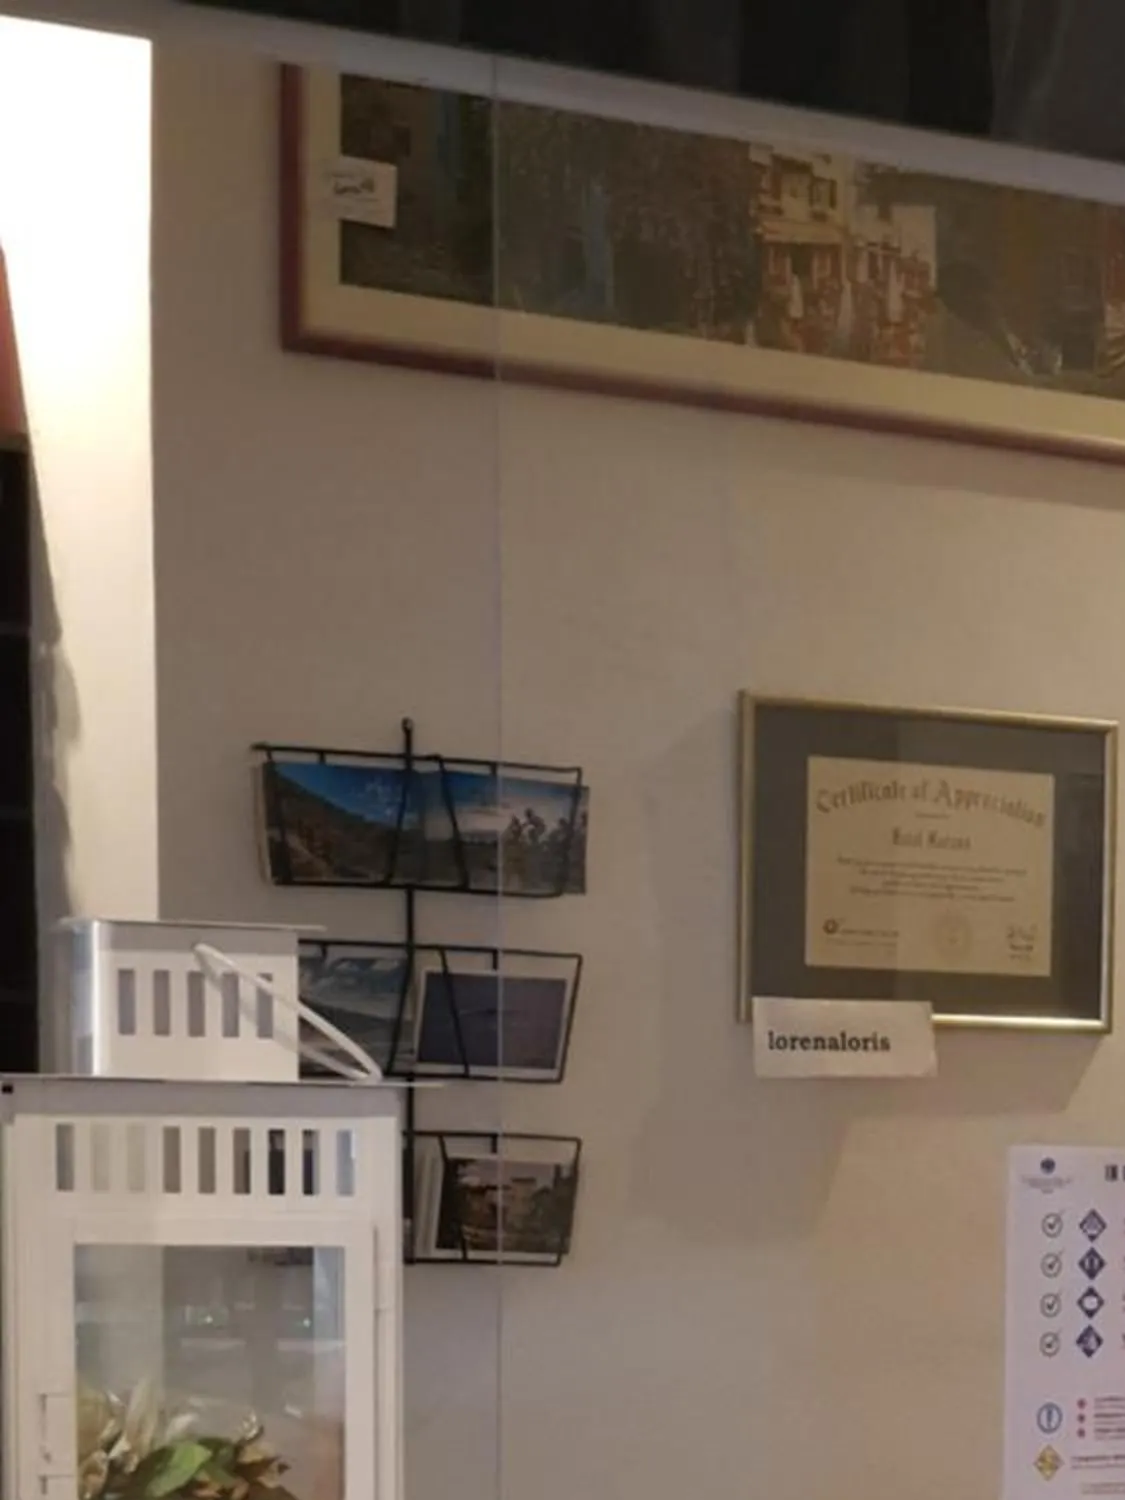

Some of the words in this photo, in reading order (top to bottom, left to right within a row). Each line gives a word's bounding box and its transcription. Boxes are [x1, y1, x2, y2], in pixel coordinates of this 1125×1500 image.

[814, 779, 907, 814] Certificate
[912, 778, 929, 800] of
[934, 779, 1047, 828] Appreciation
[768, 1031, 891, 1053] lorenaloris
[1105, 1164, 1118, 1182] IN
